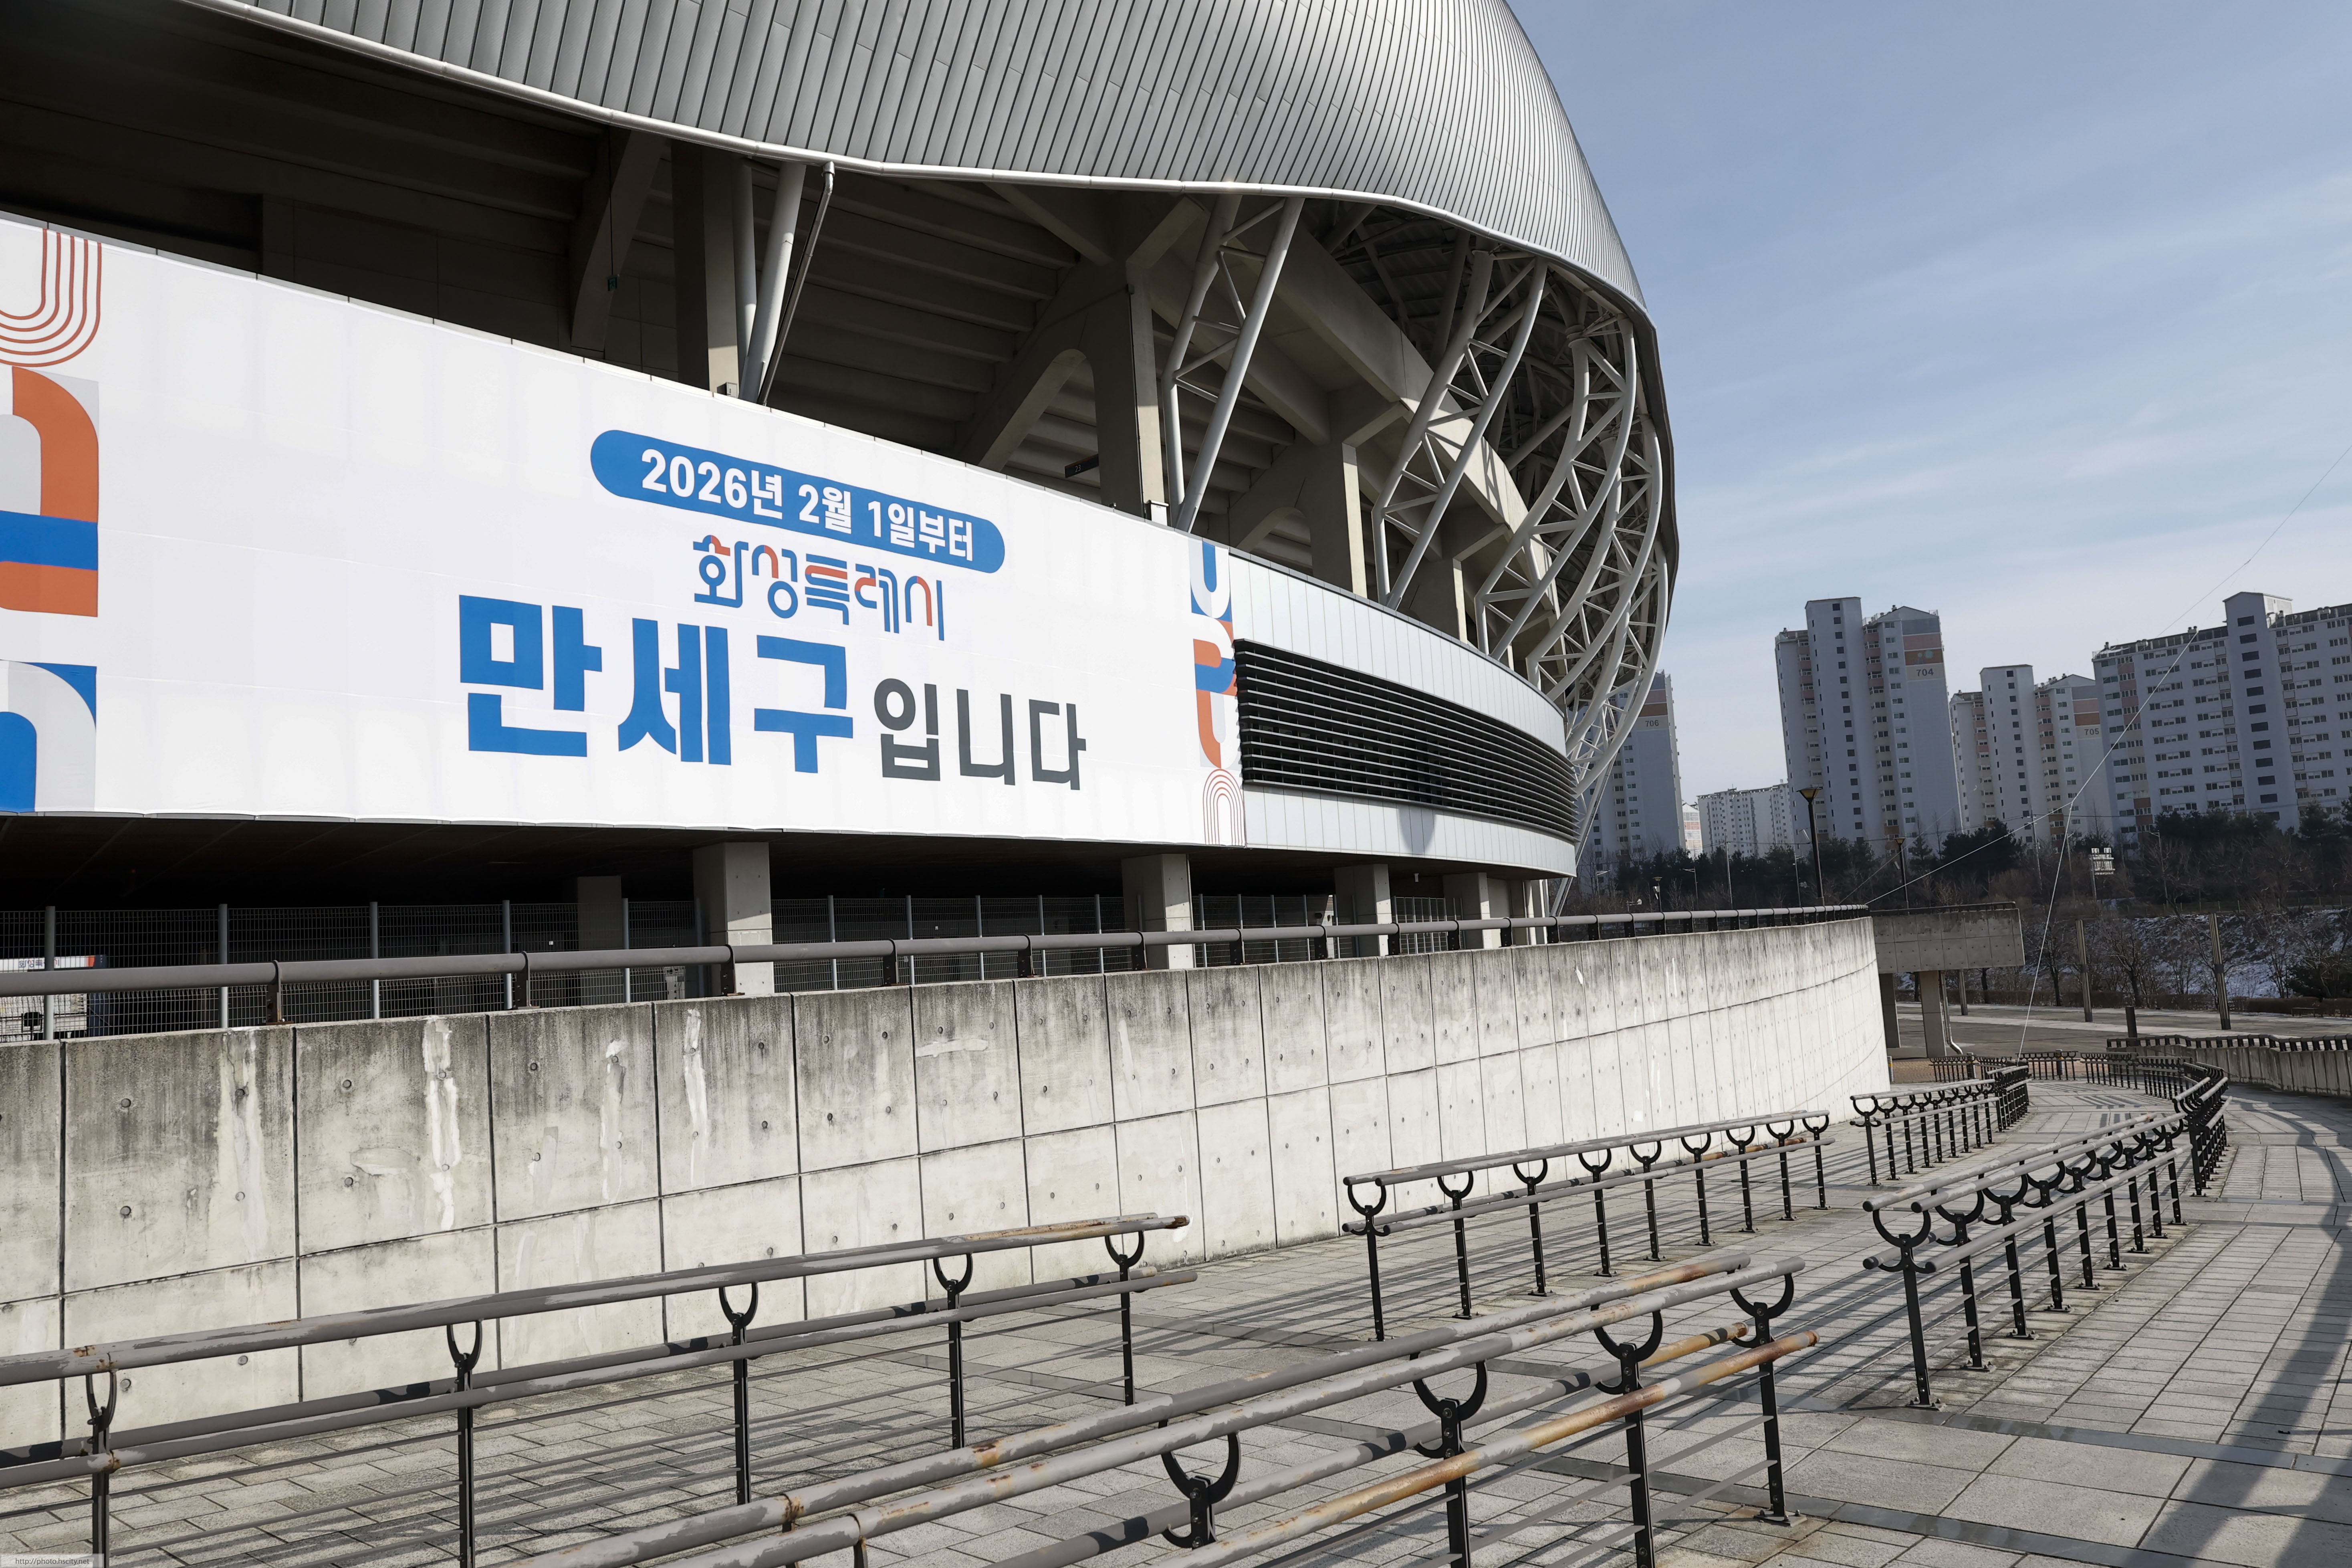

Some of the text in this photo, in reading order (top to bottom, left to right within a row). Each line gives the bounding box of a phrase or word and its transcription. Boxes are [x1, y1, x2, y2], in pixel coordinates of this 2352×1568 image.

[642, 449, 973, 561] 2026년 2월 1일부터
[1075, 464, 1081, 472] 23
[693, 535, 944, 641] 화성특례시
[459, 595, 1086, 790] 만세구입니다
[1916, 668, 1934, 676] 704
